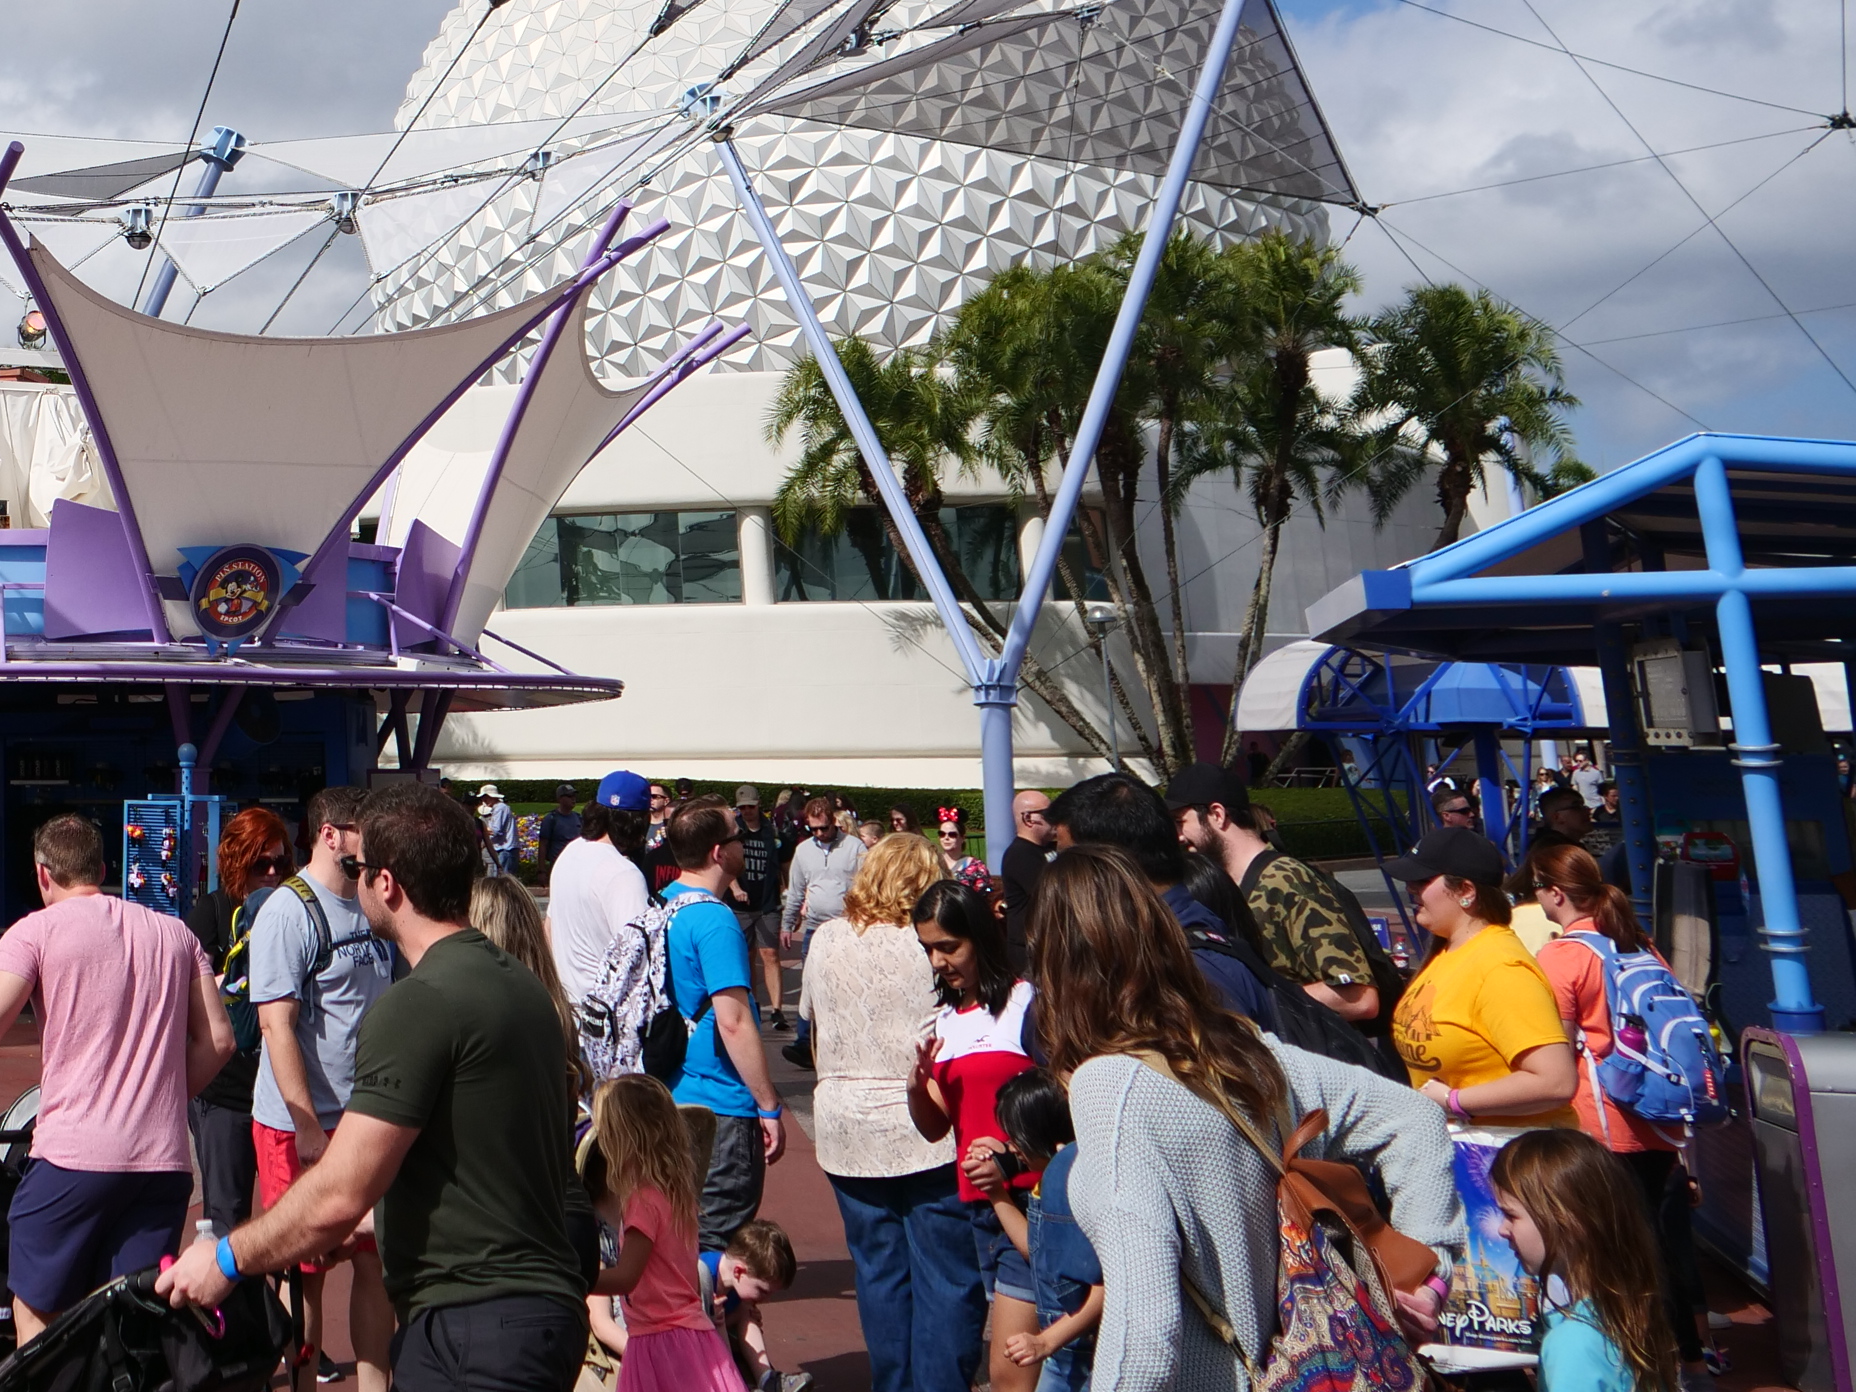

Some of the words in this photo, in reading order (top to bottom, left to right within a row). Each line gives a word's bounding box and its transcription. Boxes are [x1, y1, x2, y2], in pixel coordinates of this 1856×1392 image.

[215, 565, 231, 582] PIN
[232, 561, 267, 583] STATION
[1467, 1300, 1532, 1335] PARKS
